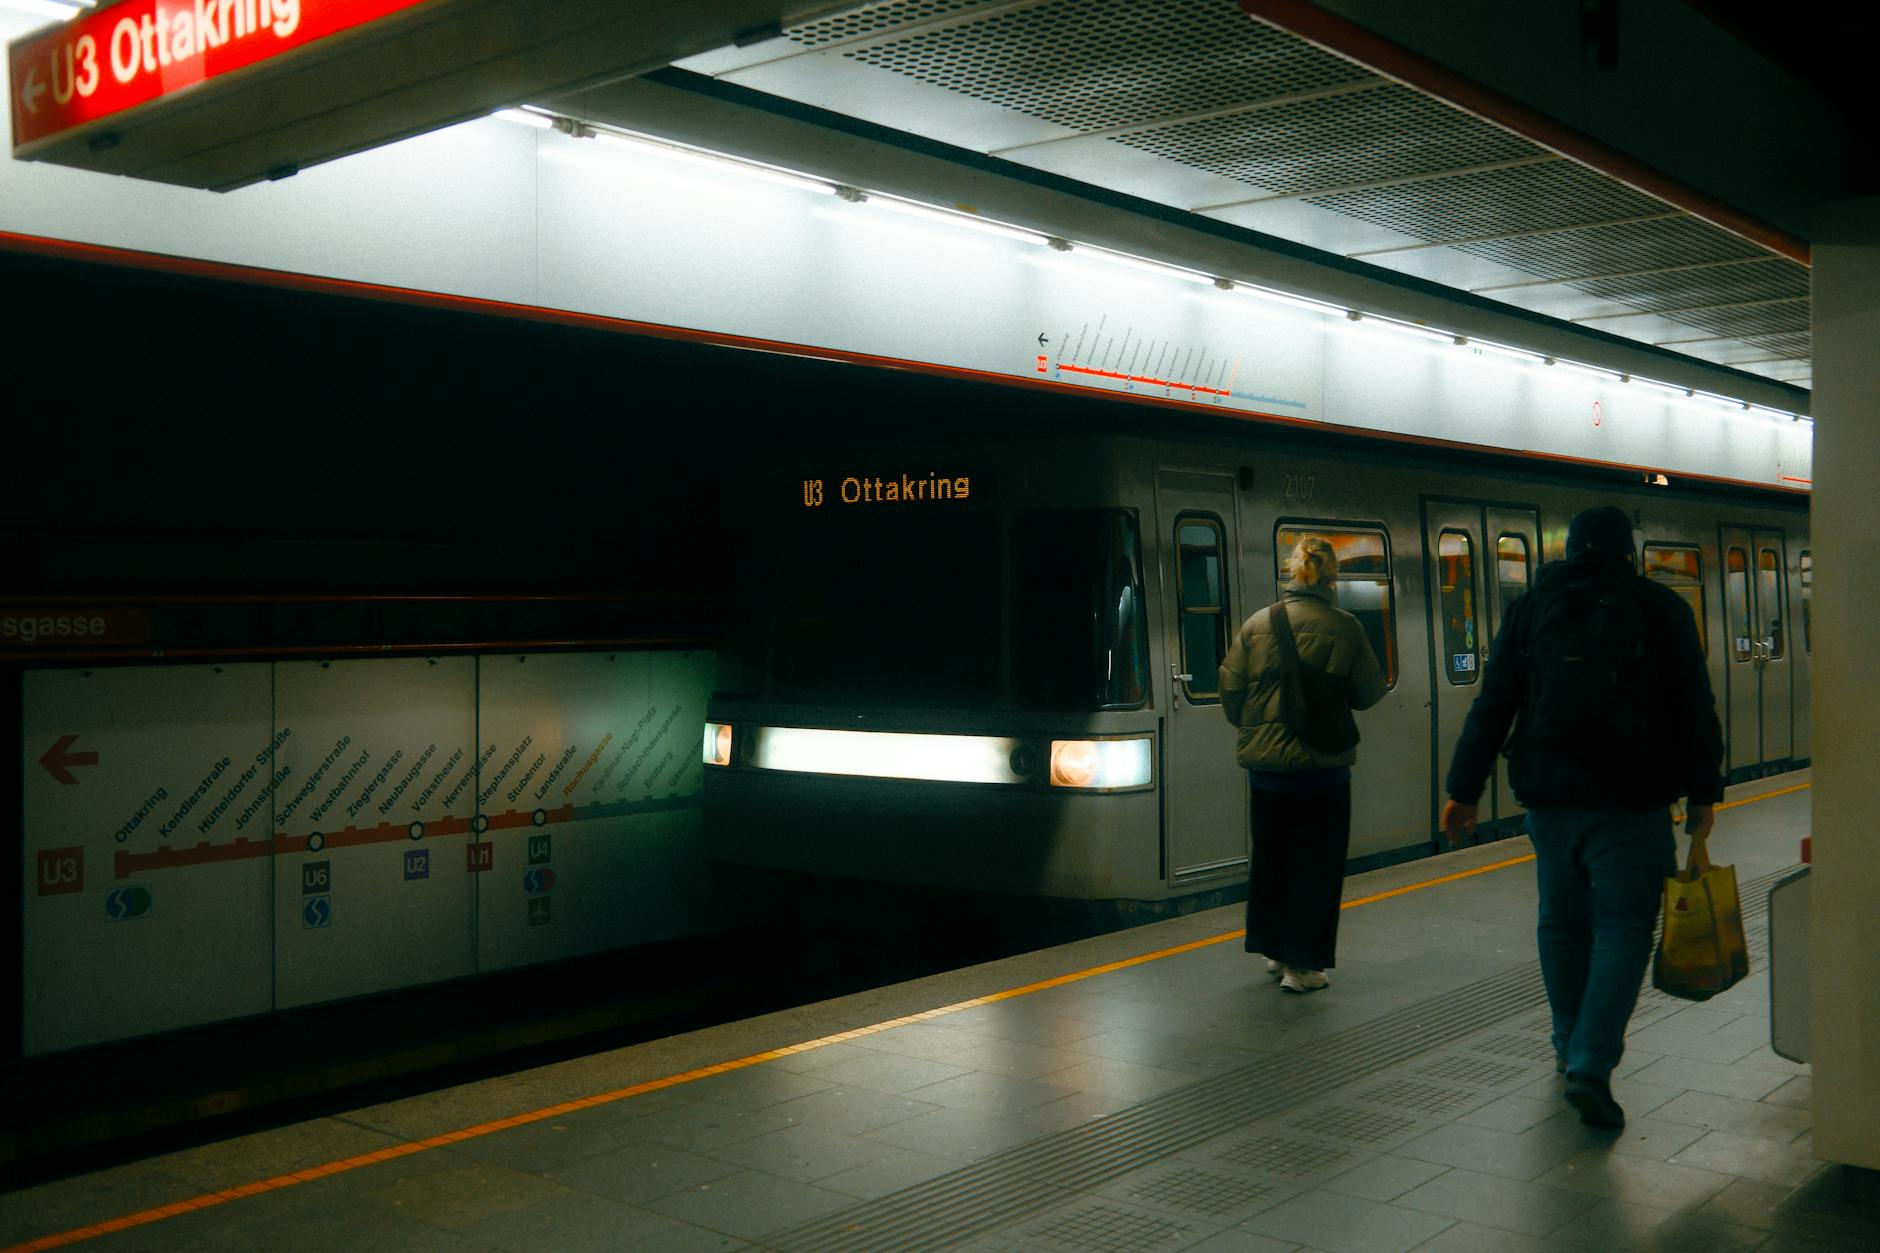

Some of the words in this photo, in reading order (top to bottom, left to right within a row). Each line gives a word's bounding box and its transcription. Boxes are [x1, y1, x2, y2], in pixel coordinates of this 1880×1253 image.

[52, 35, 98, 104] U3
[111, 0, 300, 83] Ottakring
[803, 479, 823, 507] U3
[841, 471, 969, 503] Ottakring
[1, 617, 105, 641] sgasse
[198, 764, 256, 834] Hütteldorfer
[255, 728, 291, 765] Straße
[276, 735, 351, 826] Schweglerstraße
[310, 750, 370, 822] Westbahnhof
[345, 750, 403, 818] Zieglergasse
[378, 745, 436, 815] Neubaugasse
[412, 748, 463, 812] Volkstheater
[442, 744, 497, 808] Herrengasse
[479, 735, 533, 806] Stephansplatz
[507, 753, 546, 802] Stubentor
[535, 745, 577, 800] Landstraße
[562, 733, 612, 797] Rochusgasse
[115, 787, 167, 842] Ottakring
[160, 757, 231, 838] Kendlerstraße
[236, 766, 291, 830] Johnstraße
[43, 858, 77, 885] U3
[305, 868, 327, 887] U6
[408, 856, 426, 873] U2
[471, 846, 489, 865] U1
[530, 842, 548, 858] U4
